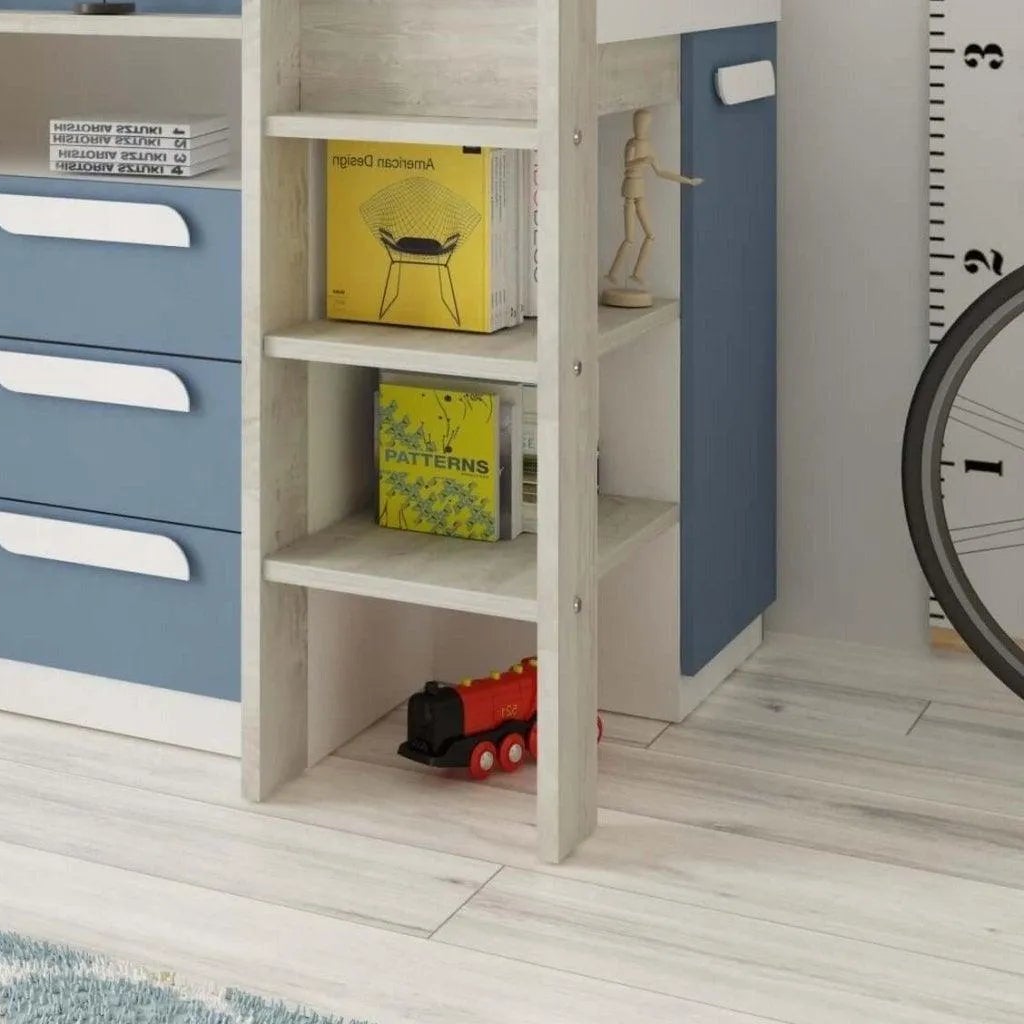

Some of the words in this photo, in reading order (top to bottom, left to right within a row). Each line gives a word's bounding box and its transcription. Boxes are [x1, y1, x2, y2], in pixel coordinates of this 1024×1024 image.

[963, 43, 1004, 70] 3
[963, 248, 1004, 276] 2
[385, 448, 489, 474] PATTERNS
[963, 458, 1004, 478] 1
